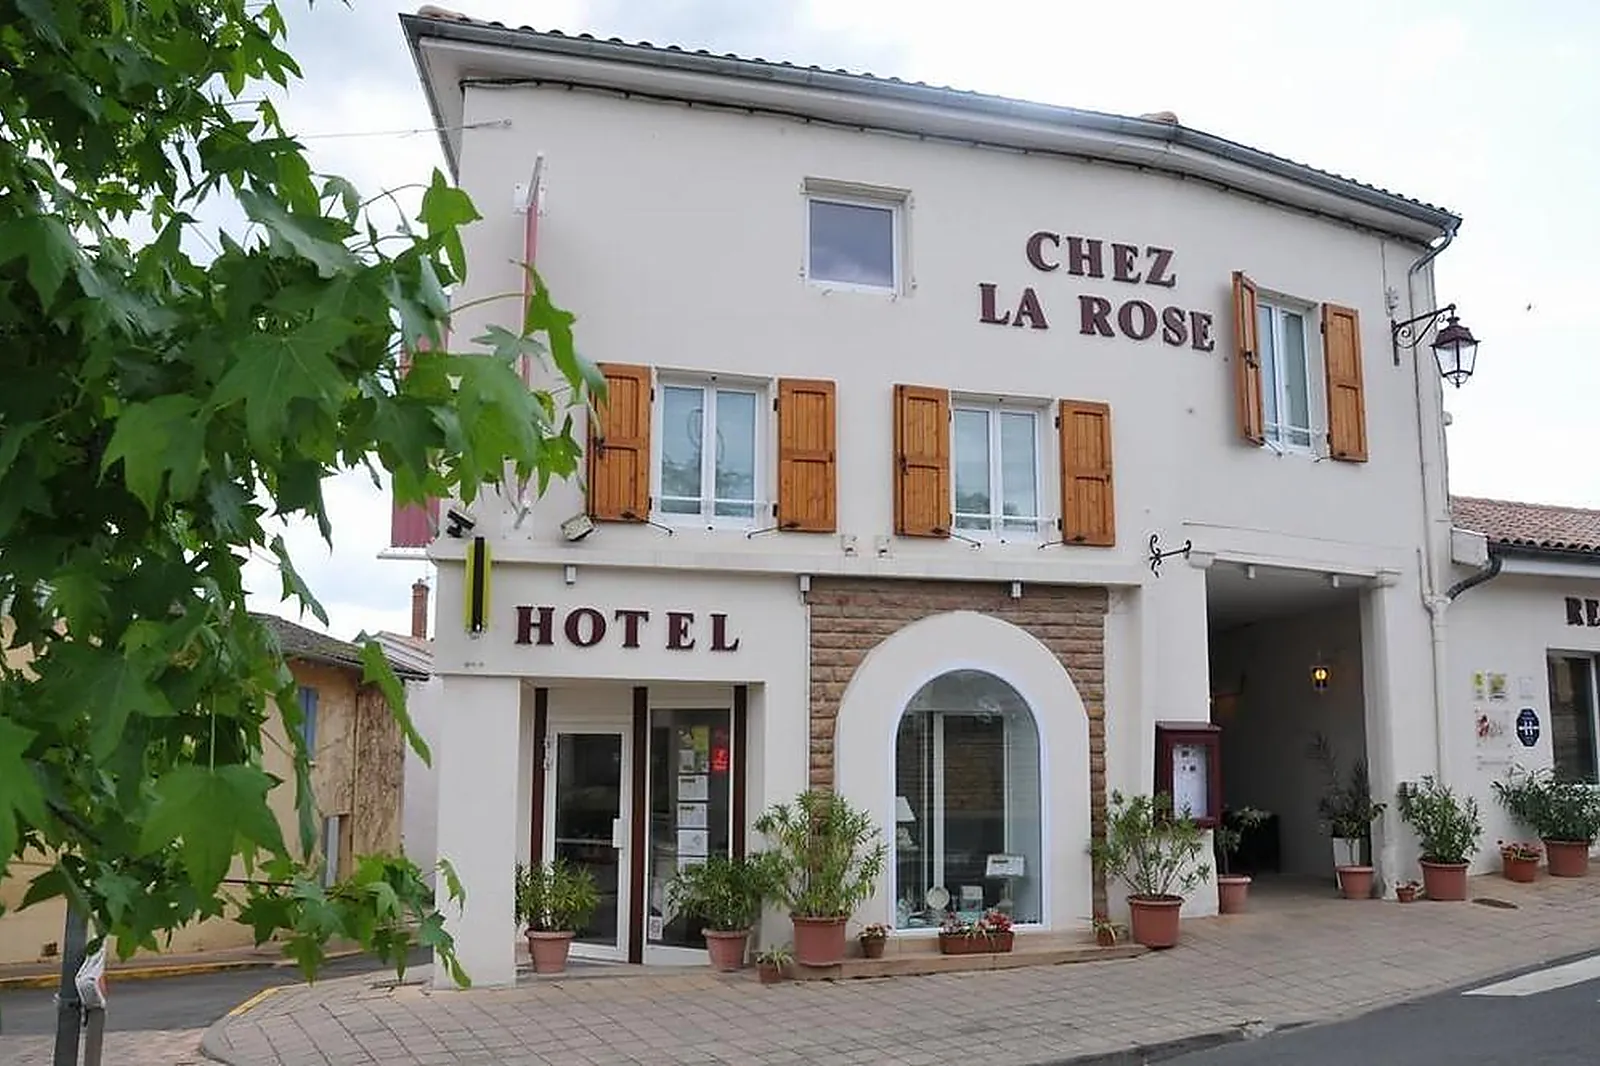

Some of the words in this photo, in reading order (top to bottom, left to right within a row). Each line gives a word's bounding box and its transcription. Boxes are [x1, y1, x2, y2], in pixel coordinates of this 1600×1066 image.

[1026, 231, 1176, 287] CHEZ
[979, 283, 1049, 329] LA
[1078, 295, 1215, 352] ROSE
[515, 606, 739, 651] HOTEL
